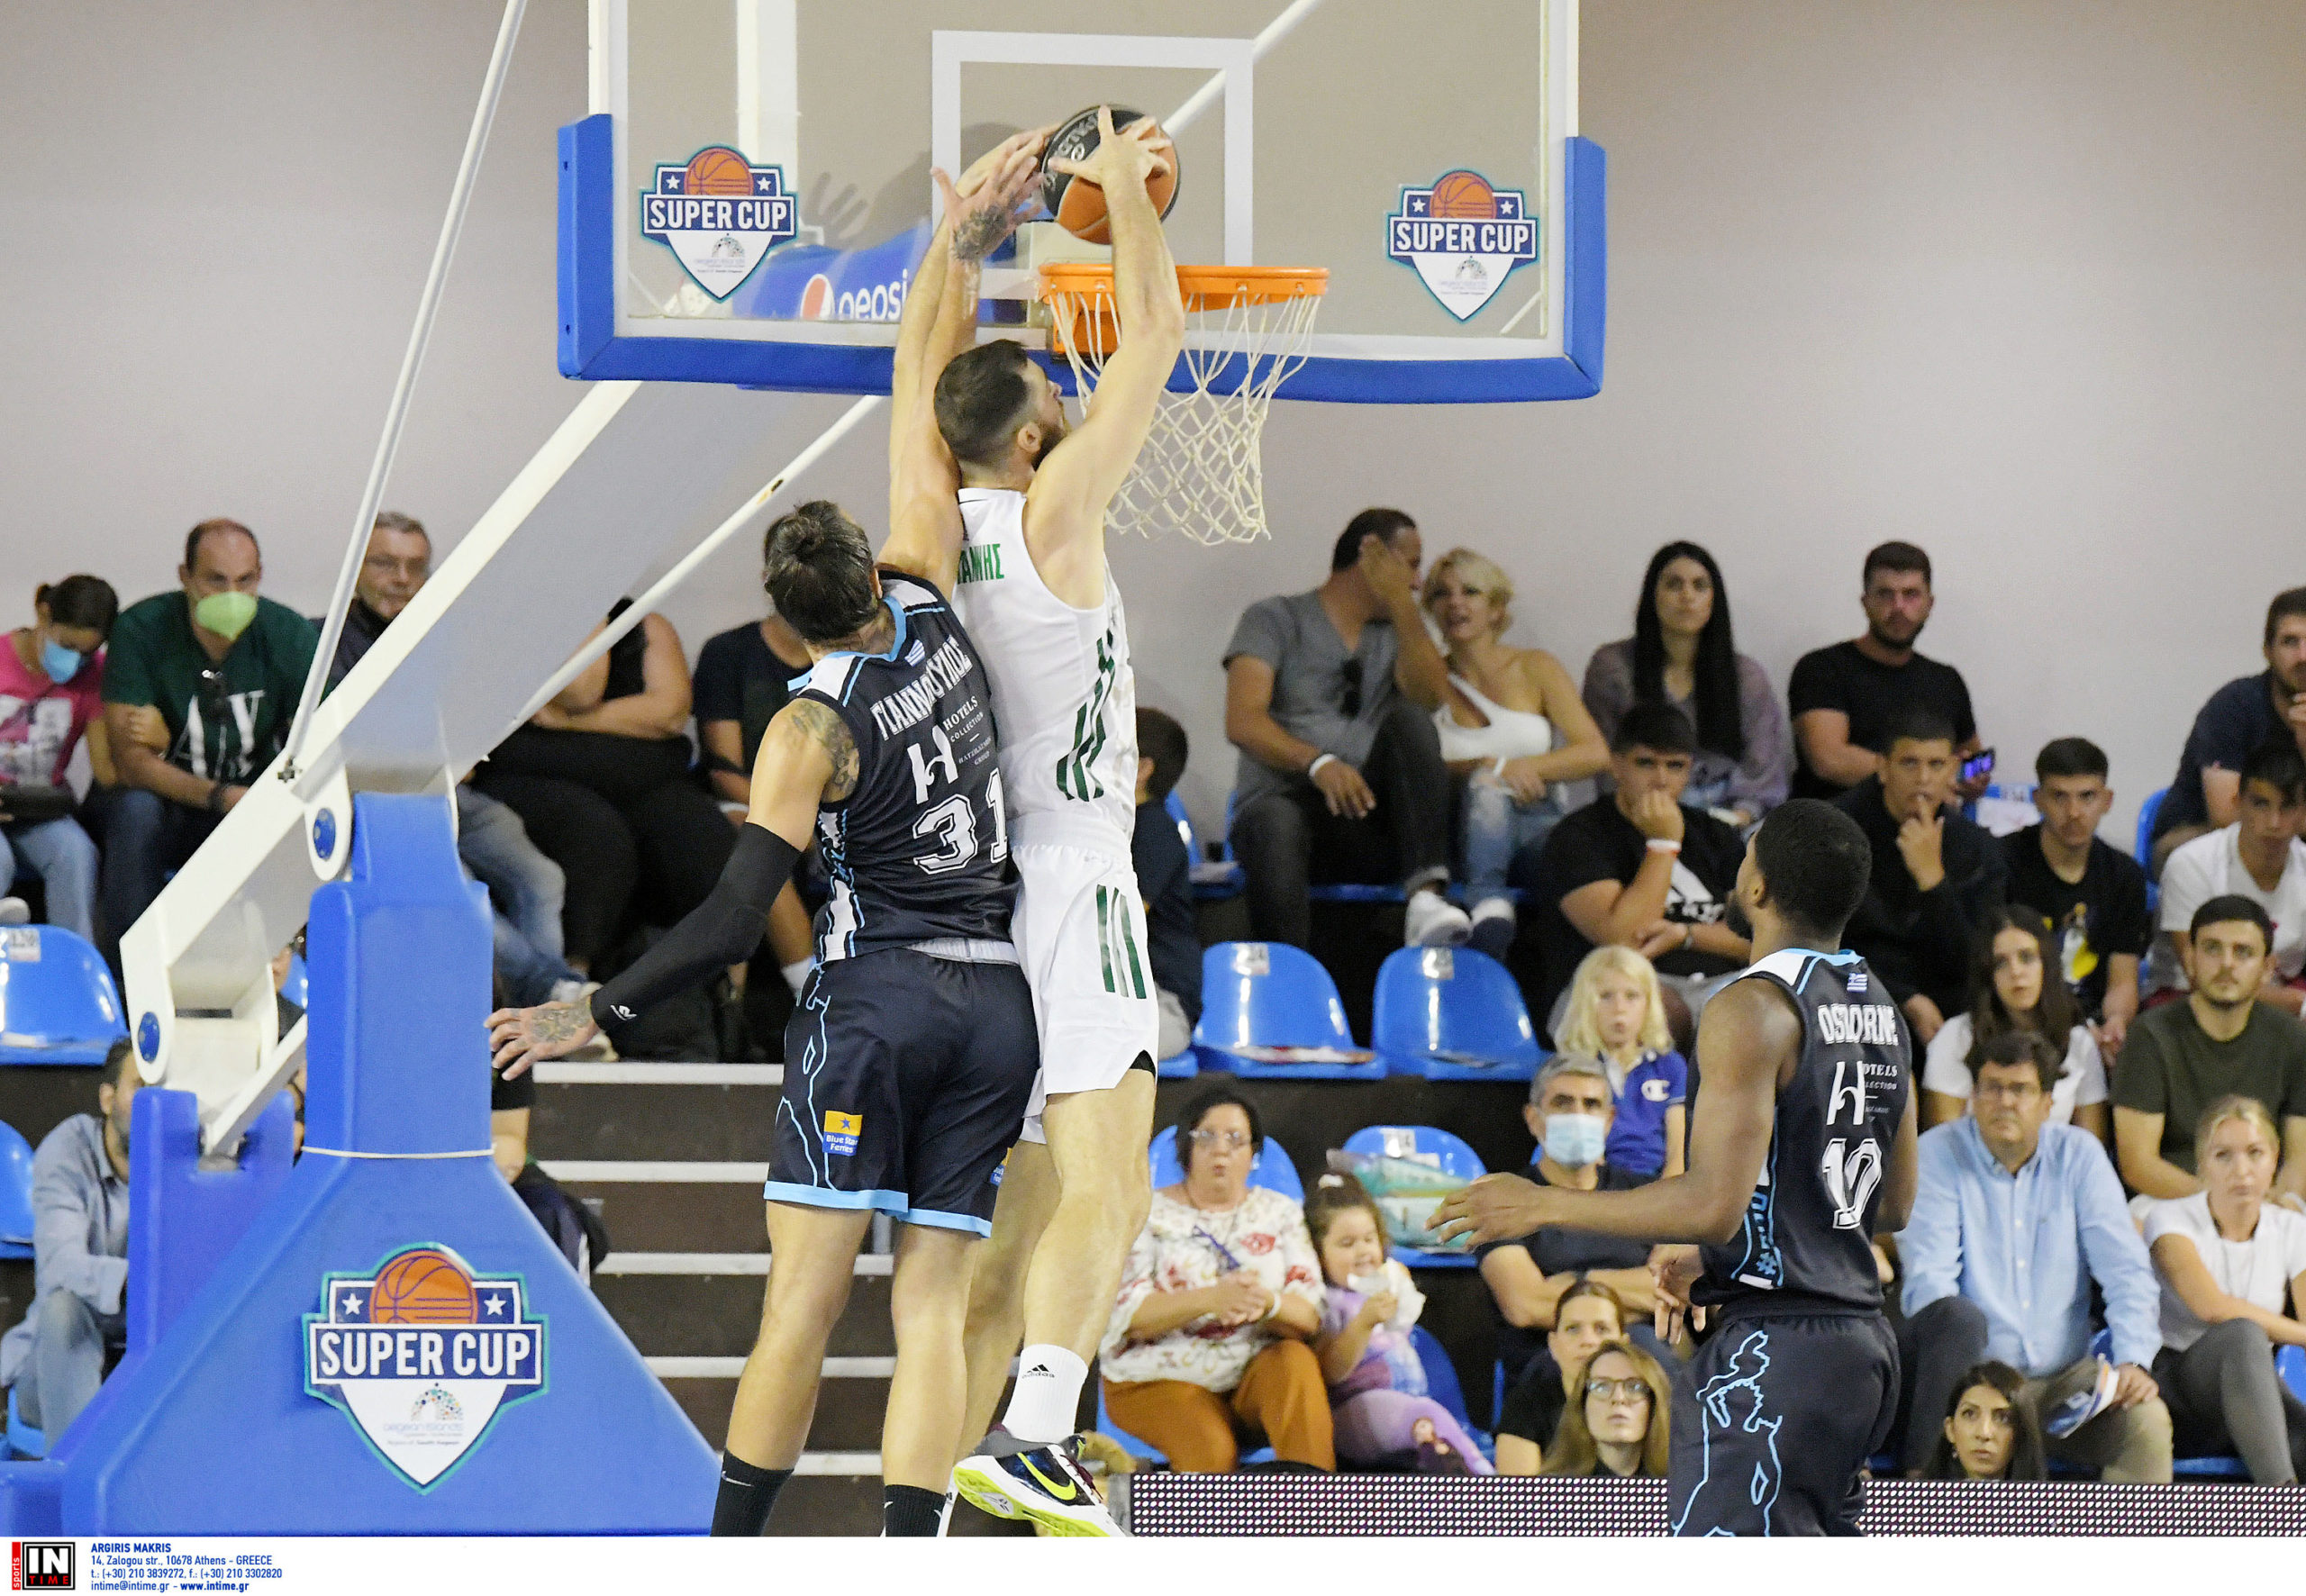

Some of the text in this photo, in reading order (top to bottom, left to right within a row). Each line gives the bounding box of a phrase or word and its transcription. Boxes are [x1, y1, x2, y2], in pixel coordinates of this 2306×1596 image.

[650, 199, 787, 230] SUPER CUP
[1396, 222, 1529, 252] SUPER CUP
[942, 695, 978, 731] HOTELS
[950, 712, 984, 743] COLLECTION
[912, 767, 1007, 875] 31
[1862, 1063, 1898, 1077] OTELS
[826, 1134, 858, 1146] Blue Star
[320, 1331, 531, 1376] SUPER CUP
